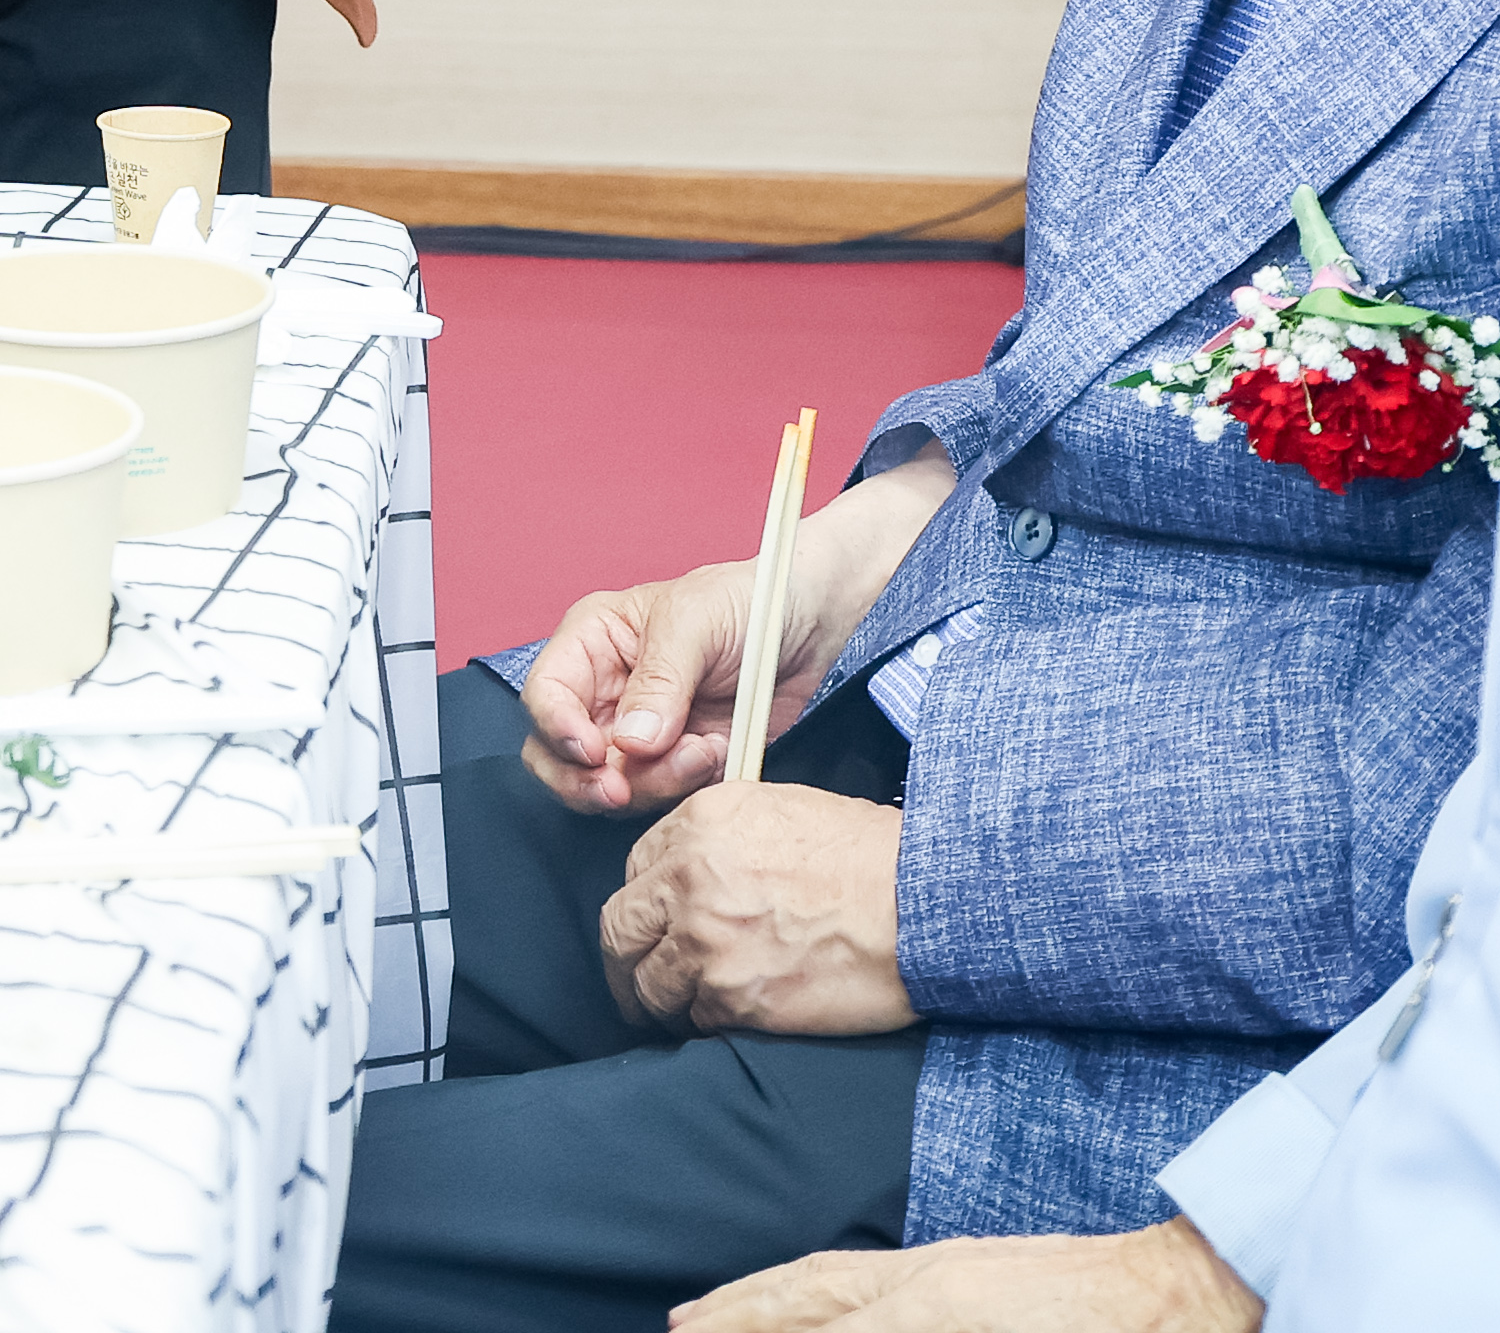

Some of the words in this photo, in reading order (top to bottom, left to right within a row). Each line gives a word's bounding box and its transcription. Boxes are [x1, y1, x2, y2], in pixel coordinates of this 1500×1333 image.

[119, 162, 149, 179] 바꾸는
[116, 171, 138, 190] 실천
[125, 188, 147, 202] Wave
